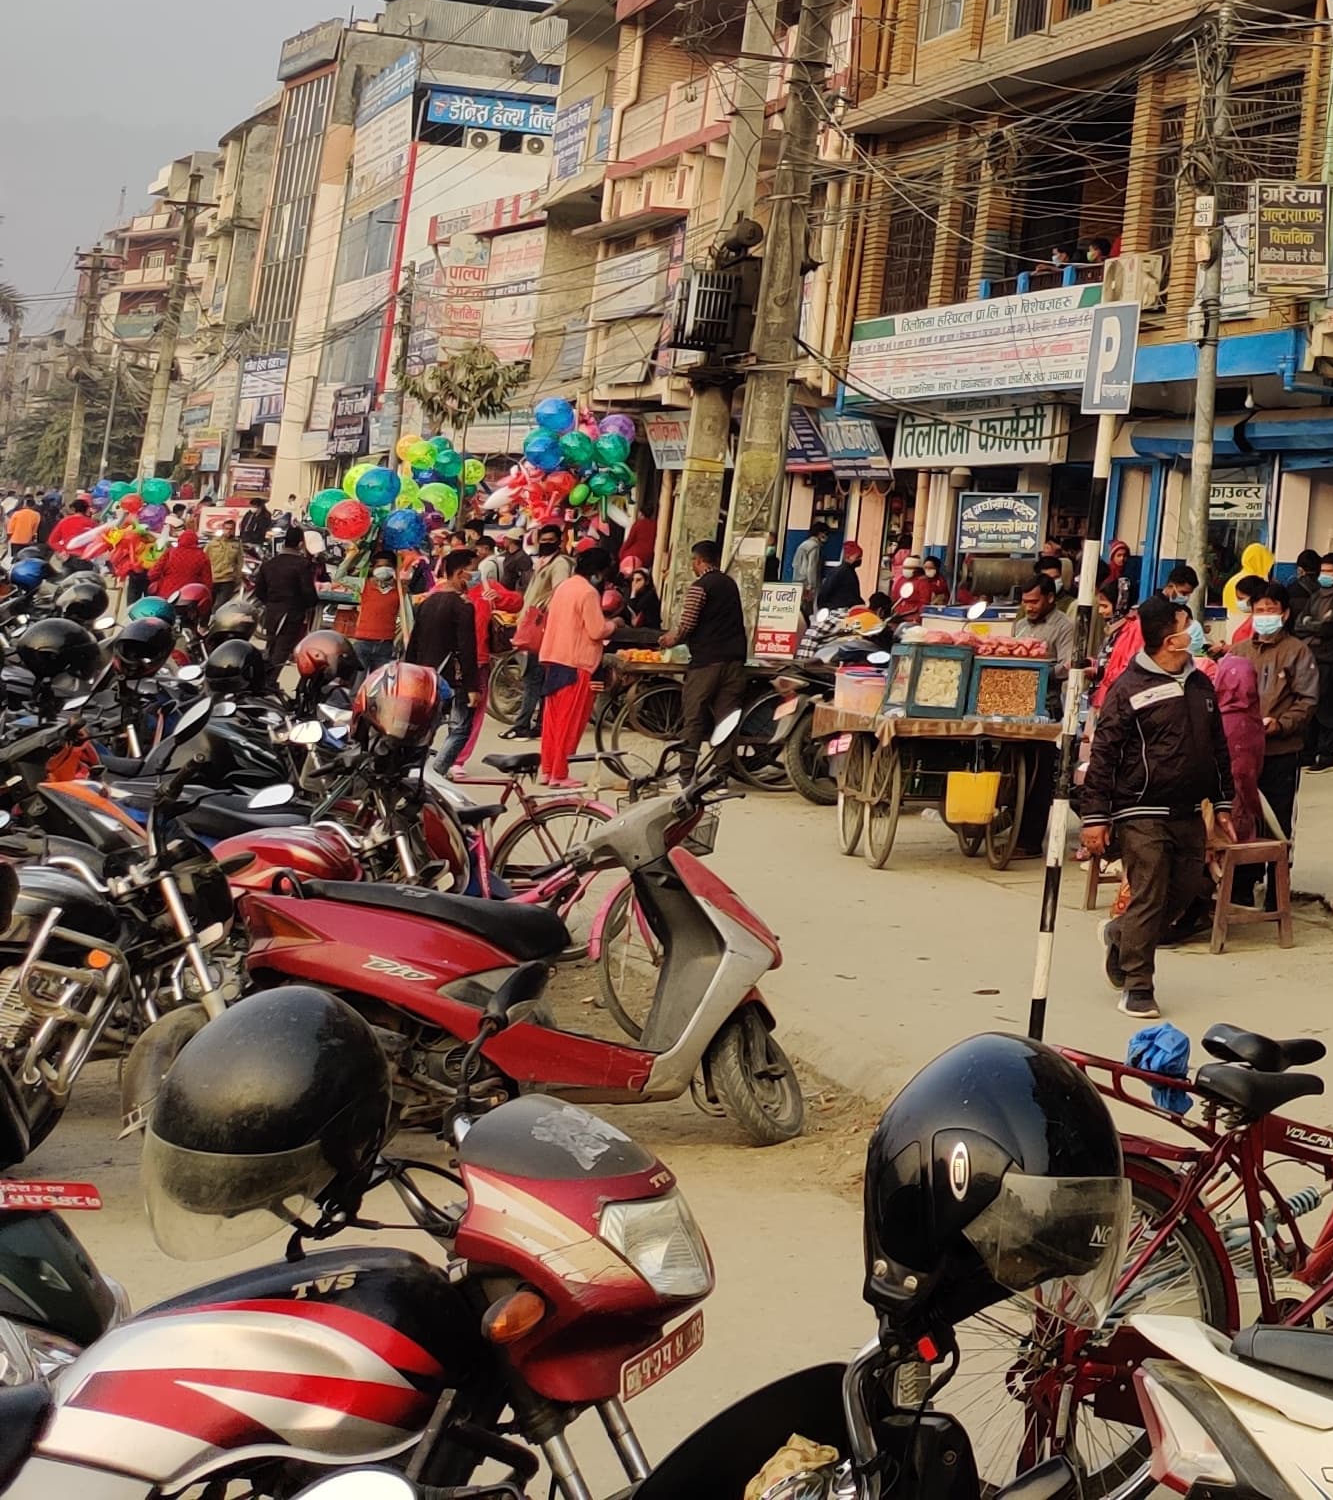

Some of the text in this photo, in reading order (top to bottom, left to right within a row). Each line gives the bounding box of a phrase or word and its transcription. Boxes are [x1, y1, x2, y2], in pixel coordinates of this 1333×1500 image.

[1262, 185, 1324, 205] गरिमा
[1093, 316, 1121, 404] P
[291, 1272, 357, 1300] TVS
